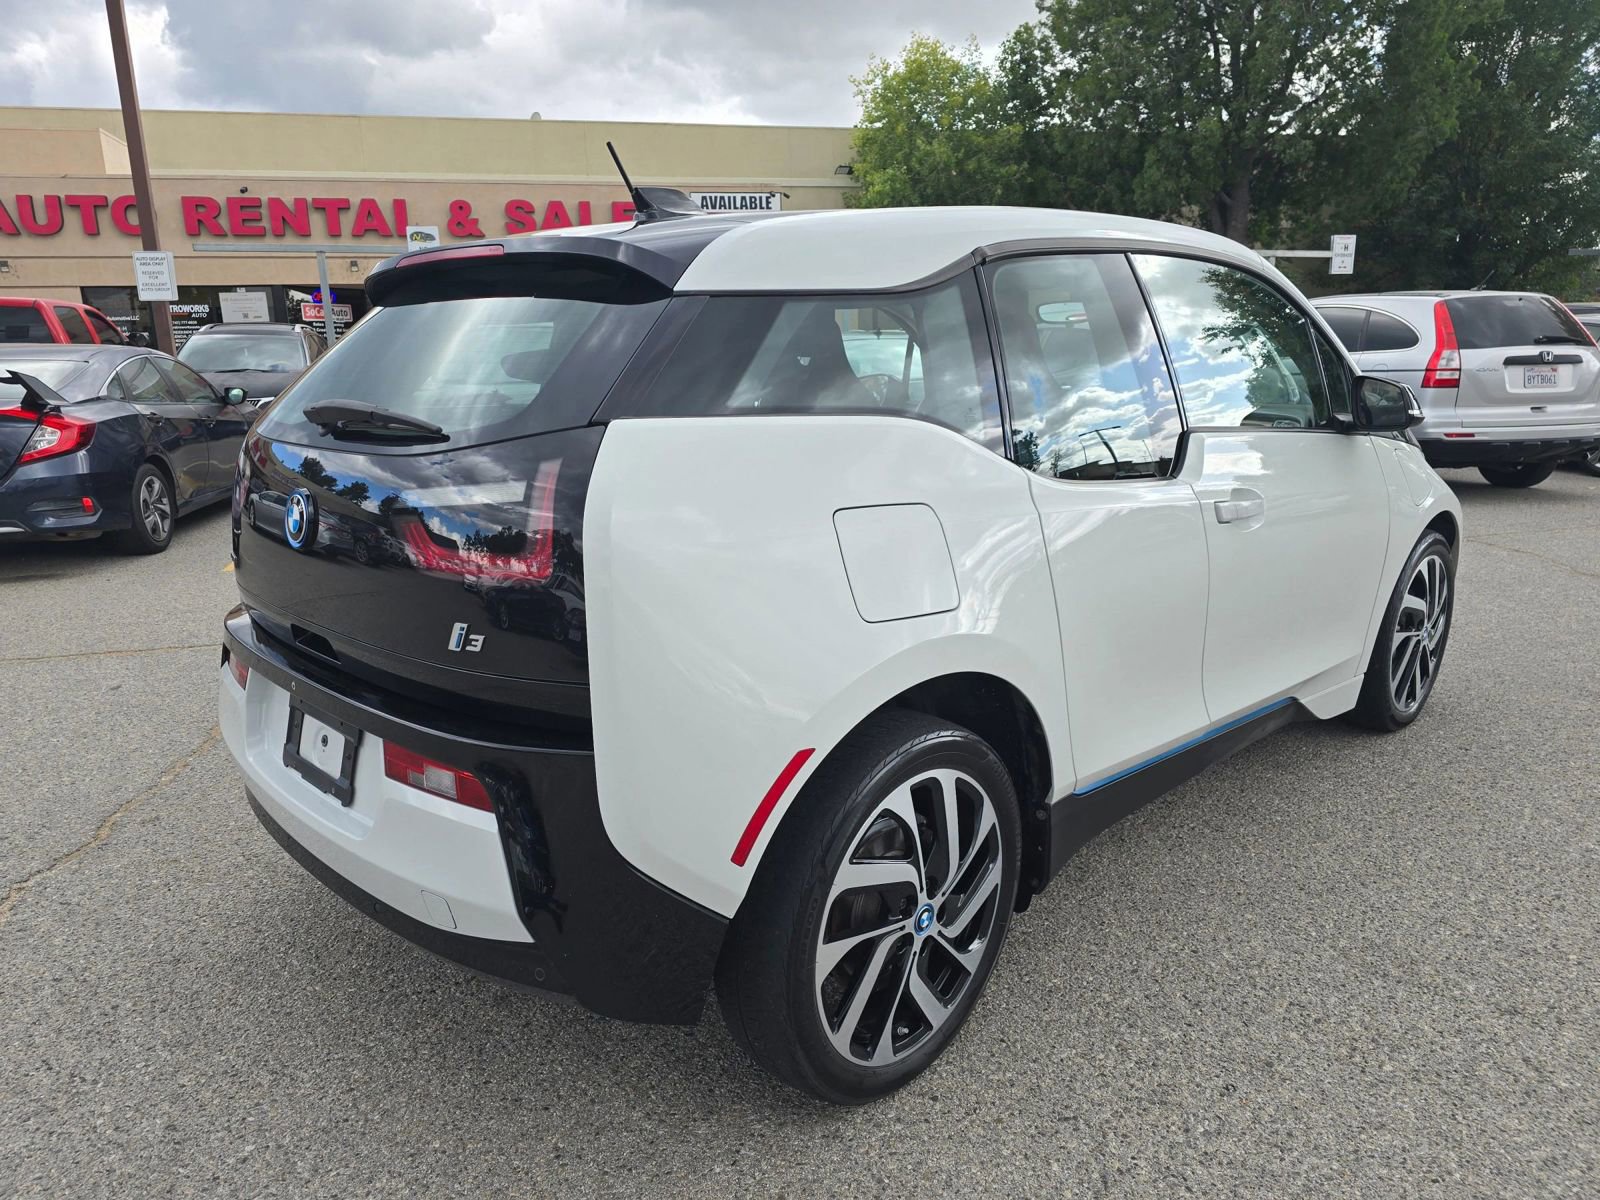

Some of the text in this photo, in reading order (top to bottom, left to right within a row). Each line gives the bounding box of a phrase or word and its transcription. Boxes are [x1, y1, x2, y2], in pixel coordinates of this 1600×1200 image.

[700, 195, 772, 210] AVAILABLE
[180, 196, 408, 238] RENTAL
[448, 199, 485, 238] &
[305, 306, 325, 317] SoCa
[1527, 374, 1557, 385] 8YTB061
[448, 622, 485, 652] i3
